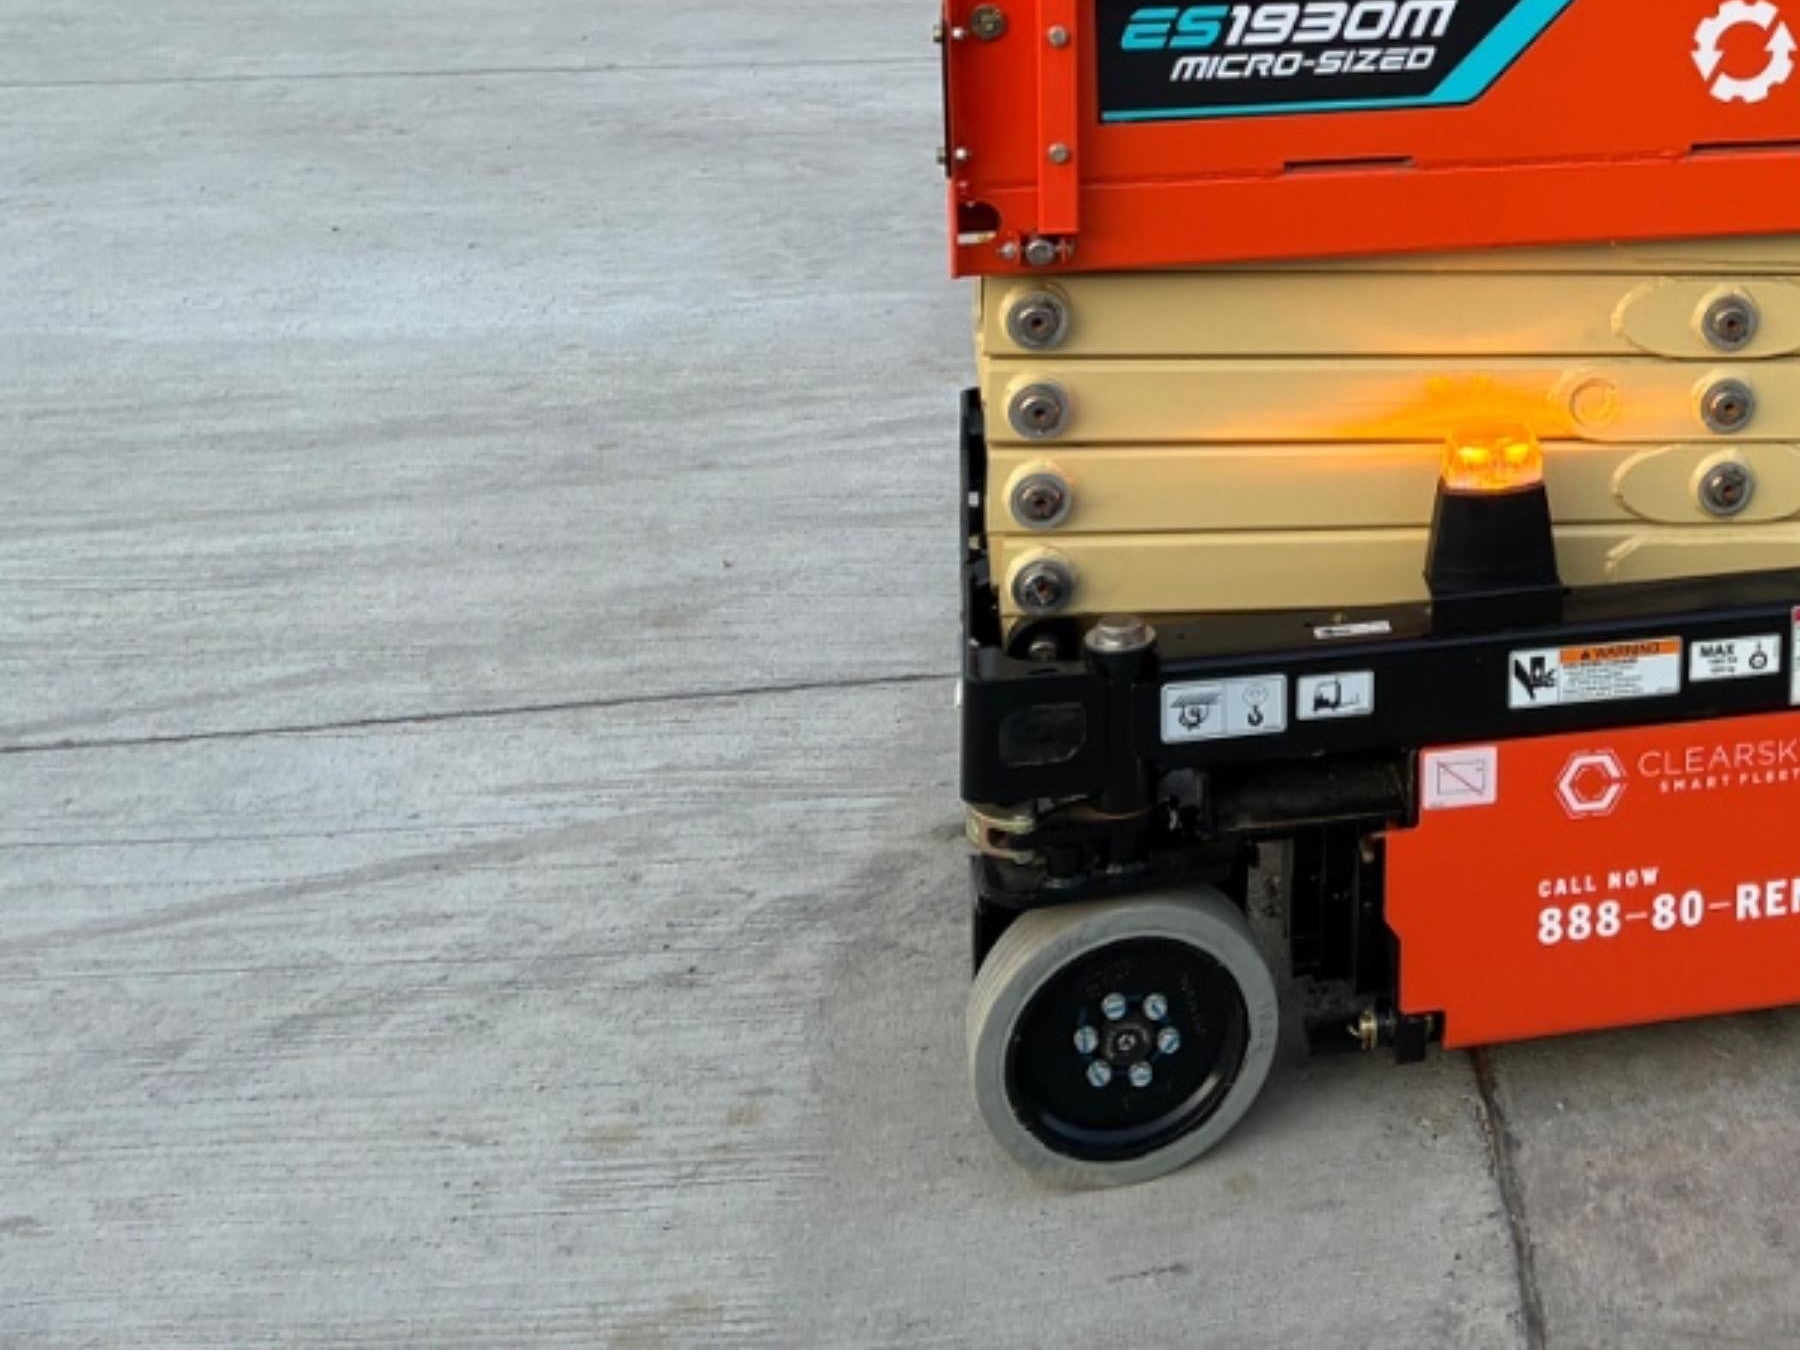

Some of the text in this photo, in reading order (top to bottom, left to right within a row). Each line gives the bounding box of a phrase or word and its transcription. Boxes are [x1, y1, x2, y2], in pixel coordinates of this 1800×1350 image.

[1168, 46, 1438, 82] MICRO-SIZED
[1699, 642, 1736, 658] MAX
[1660, 774, 1731, 793] SMART
[1538, 866, 1660, 898] CALL NOW
